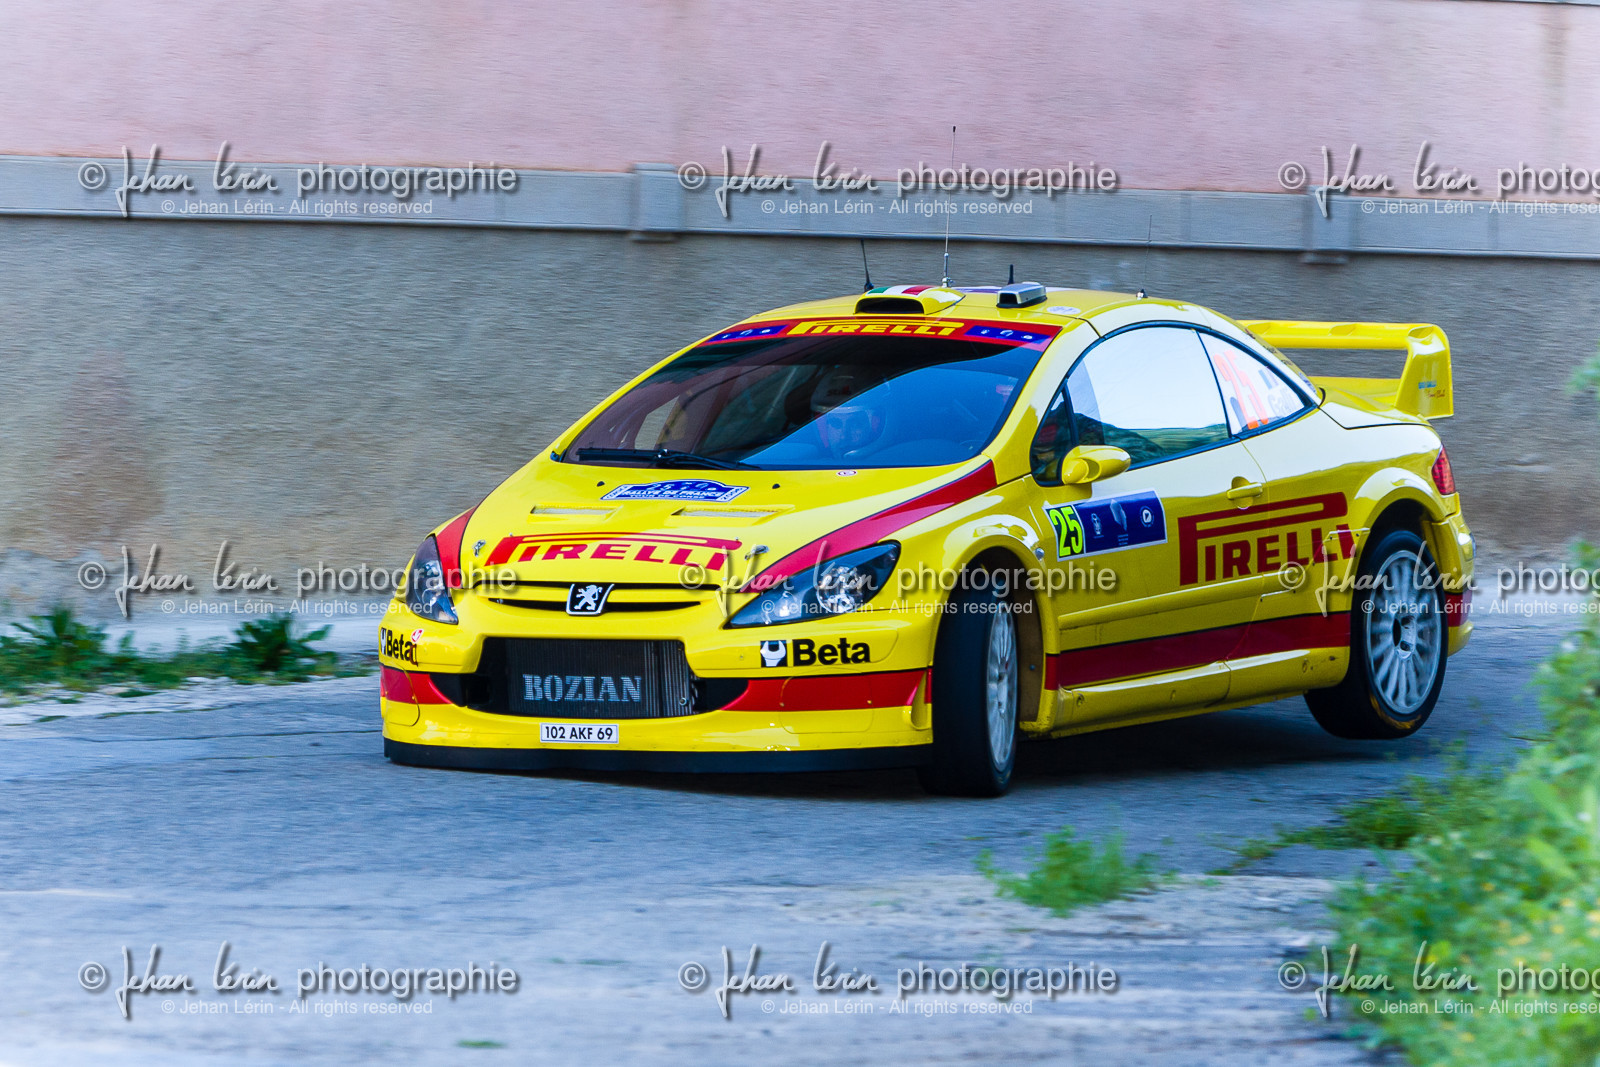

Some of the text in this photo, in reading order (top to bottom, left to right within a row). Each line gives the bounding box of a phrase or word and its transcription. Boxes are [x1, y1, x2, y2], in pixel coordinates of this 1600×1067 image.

[786, 318, 964, 336] PIRELLI
[1049, 506, 1083, 557] 25
[1177, 491, 1357, 586] PIRELLI
[484, 531, 743, 571] PIRELLI
[792, 637, 871, 667] Beta
[522, 674, 642, 702] BOZIAN
[545, 726, 613, 740] 102 AKF 69
